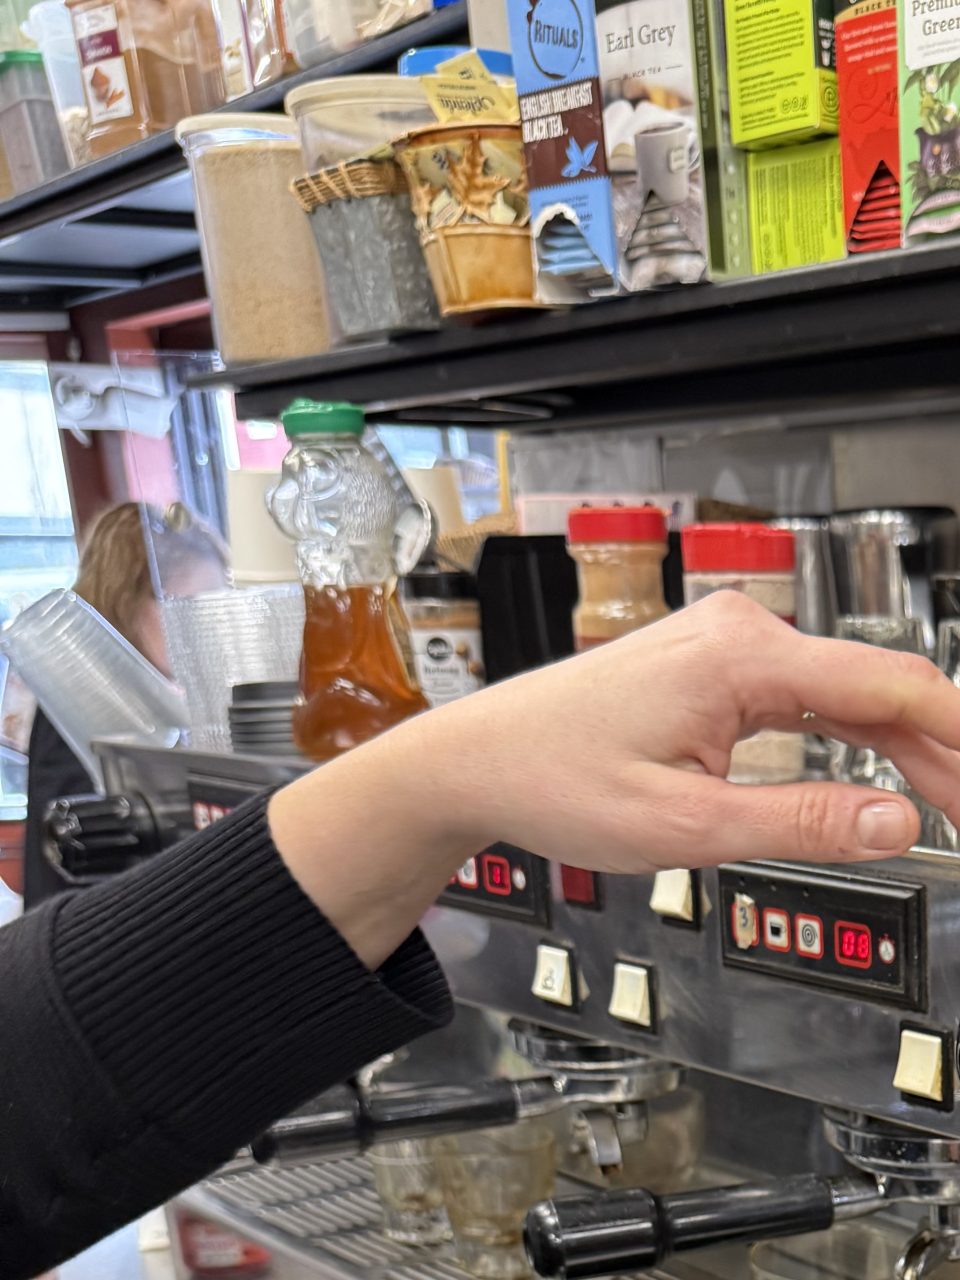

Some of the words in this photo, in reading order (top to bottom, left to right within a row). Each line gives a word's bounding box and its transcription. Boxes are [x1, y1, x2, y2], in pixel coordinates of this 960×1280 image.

[534, 19, 579, 49] RITUALS
[605, 27, 634, 53] Earl
[638, 24, 676, 47] Grey
